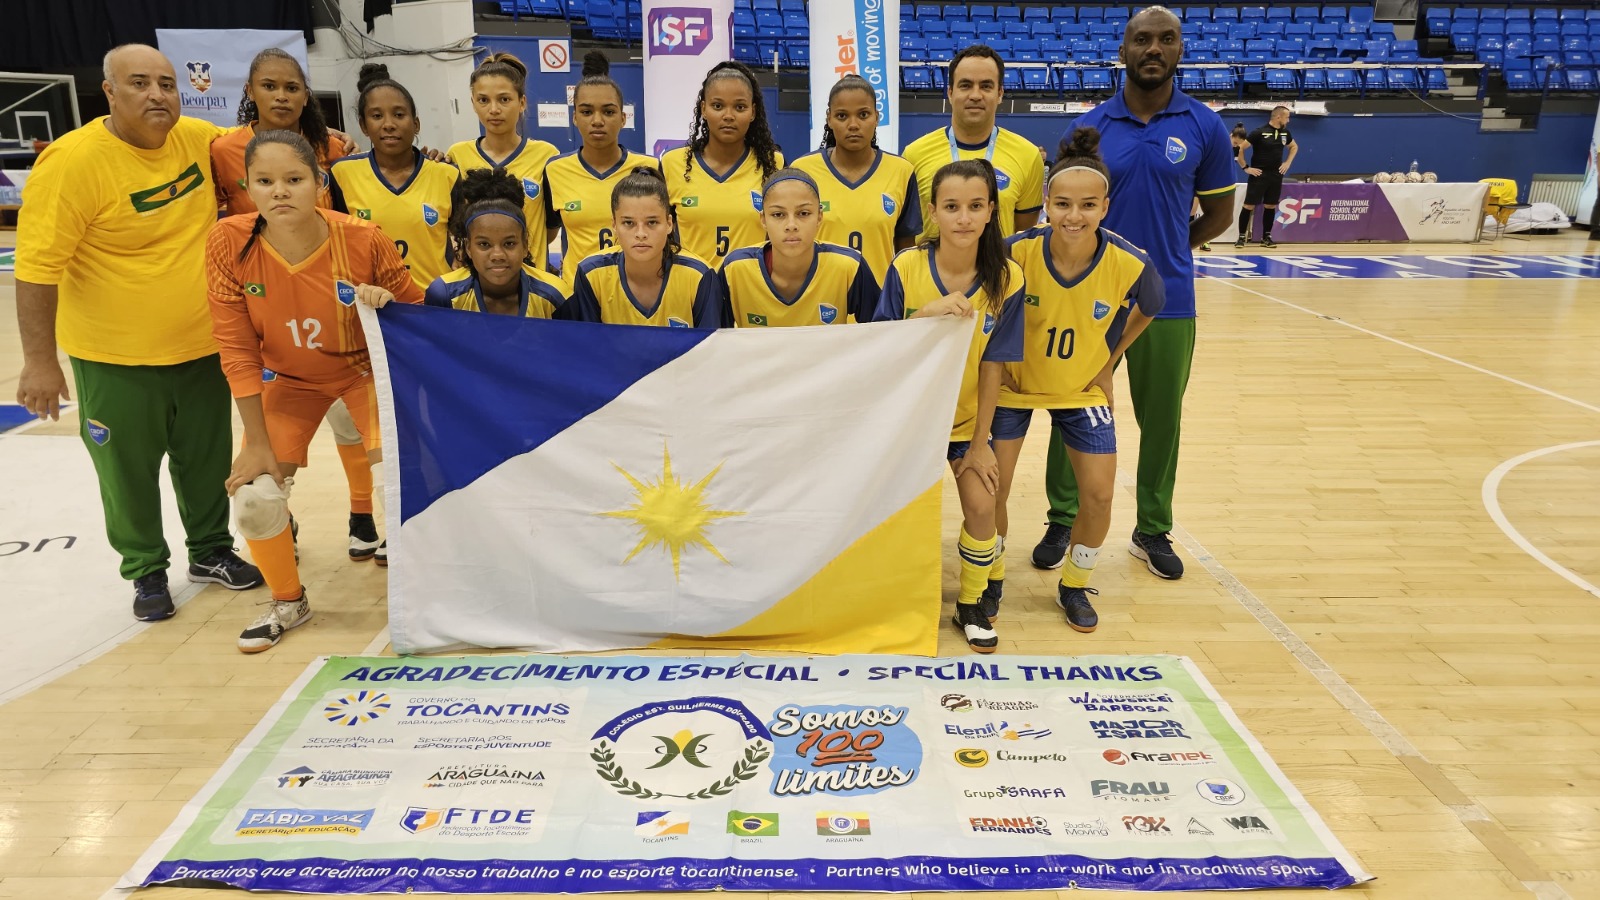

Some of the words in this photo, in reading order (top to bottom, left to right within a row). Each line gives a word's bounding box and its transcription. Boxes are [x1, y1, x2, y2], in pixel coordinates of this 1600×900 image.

[653, 16, 705, 47] ISF
[862, 0, 881, 62] moving
[864, 66, 882, 85] of
[181, 92, 228, 110] Београд
[1168, 145, 1183, 153] CBDE
[1330, 199, 1370, 207] INTERNATIONAL
[1276, 198, 1321, 224] SF
[599, 228, 613, 250] 6
[716, 226, 730, 257] 5
[1193, 255, 1600, 270] ORTOV
[285, 317, 323, 350] 12
[1045, 326, 1075, 360] 10
[1084, 405, 1113, 428] 10
[340, 663, 650, 682] AGRADECIMENTO
[657, 661, 820, 682] ESPECIAL
[867, 661, 1010, 682] SPECIAL
[1017, 664, 1163, 682] THANKS
[406, 703, 570, 717] TOCANTINS
[1083, 704, 1170, 713] BARBOSA
[472, 718, 519, 726] CUIDANDO
[535, 717, 567, 725] TODOS
[608, 713, 644, 736] COLÉGIO
[645, 706, 666, 716] EST.
[667, 701, 724, 711] GUILHERME
[770, 706, 905, 737] Somos
[1088, 719, 1185, 731] MAJOR
[1094, 728, 1192, 739] ISRAEL
[483, 741, 553, 749] JUVENTUDE
[796, 729, 885, 758] 100
[1130, 751, 1214, 762] Aranet
[448, 780, 477, 788] CIDADE
[774, 762, 915, 796] limites
[963, 789, 1003, 799] Grupo
[1008, 787, 1066, 798] SAAFA
[1090, 779, 1170, 796] FRAU
[247, 811, 315, 826] FÁBIO
[323, 813, 367, 823] VAZ
[444, 807, 535, 824] FTDE
[239, 827, 293, 836] SECRETÁRIO
[972, 826, 1052, 836] FERNANDES
[1063, 821, 1092, 829] Studio
[1065, 828, 1109, 837] Moving
[452, 830, 494, 838] Desporto
[642, 835, 679, 844] TOCANTINS
[171, 865, 257, 879] Parceiros
[260, 866, 296, 879] que
[299, 864, 391, 879] acreditam
[395, 865, 417, 878] no
[423, 865, 477, 879] nosso
[481, 865, 560, 879] trabalho
[564, 866, 576, 877] e
[579, 867, 603, 879] no
[608, 865, 675, 880] esporte
[681, 864, 799, 878] tocantinense.
[826, 864, 900, 877] Partners
[905, 862, 942, 876] who
[948, 863, 1010, 876] believe
[1014, 863, 1031, 874] in
[1071, 863, 1117, 876] work
[1122, 864, 1155, 876] and
[1159, 862, 1177, 875] in
[1180, 863, 1267, 877] Tocantins
[1270, 864, 1324, 878] sport.
